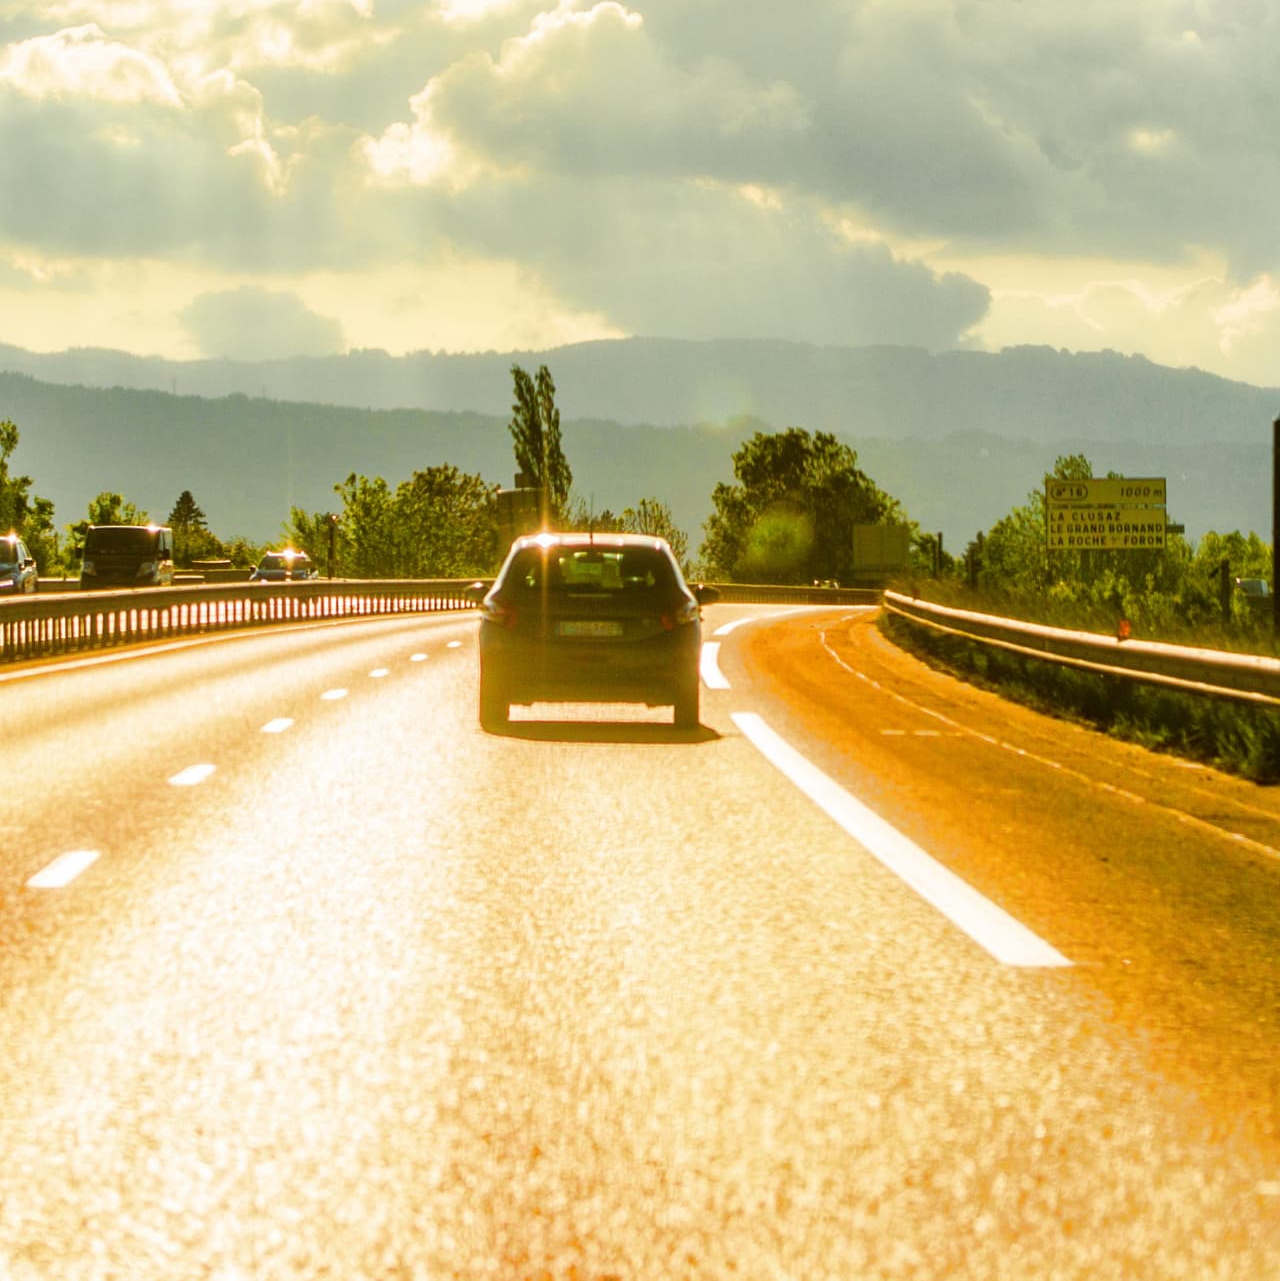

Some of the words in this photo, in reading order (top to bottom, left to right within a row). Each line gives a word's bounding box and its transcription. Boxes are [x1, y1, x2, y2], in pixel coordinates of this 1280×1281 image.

[1120, 487, 1150, 497] 1000
[1153, 489, 1162, 497] m
[1050, 511, 1065, 521] LA
[1072, 511, 1121, 521] CLUSAZ
[1050, 524, 1064, 533] LE
[1067, 523, 1105, 533] GRAND
[1108, 523, 1163, 533] BORNAND
[1050, 536, 1064, 545] LA
[1068, 535, 1106, 545] ROCHE
[1123, 535, 1163, 545] FORON
